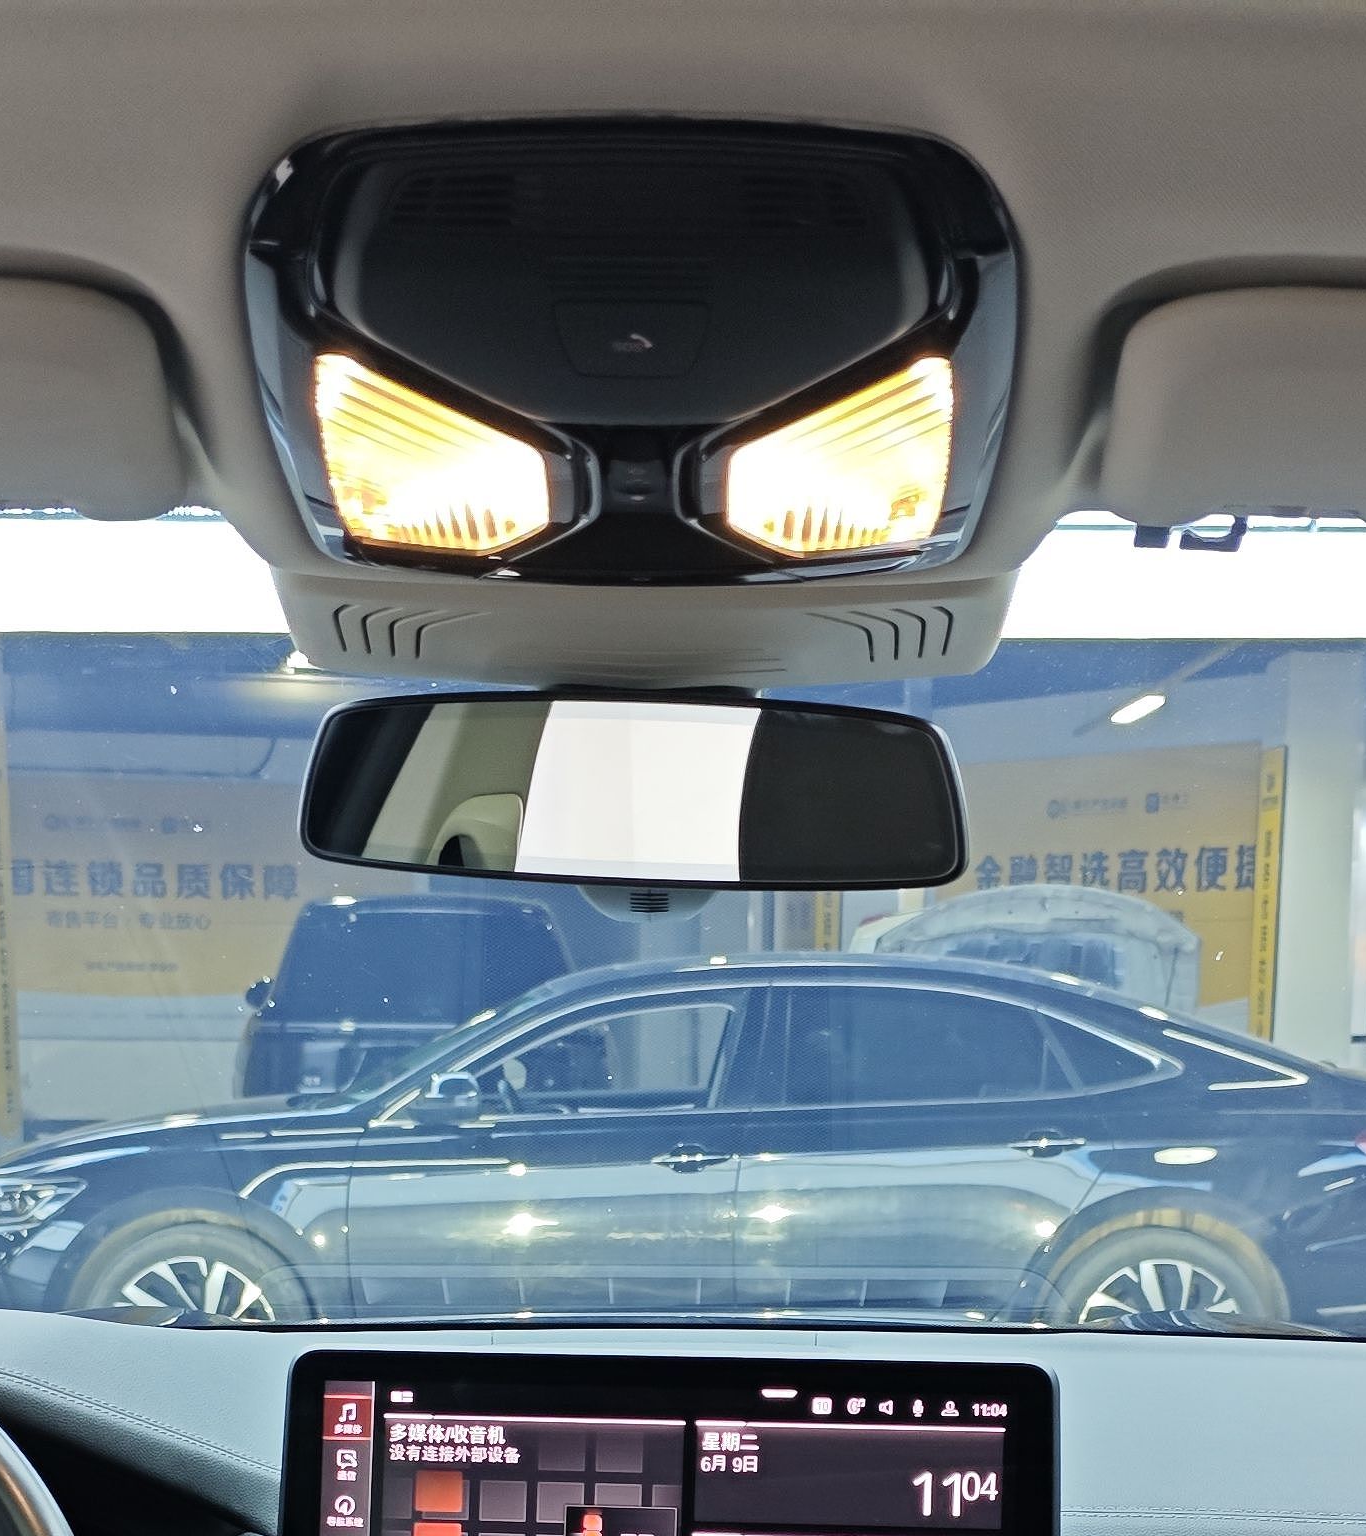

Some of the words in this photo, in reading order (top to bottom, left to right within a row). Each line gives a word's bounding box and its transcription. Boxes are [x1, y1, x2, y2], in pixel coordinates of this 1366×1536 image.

[971, 1403, 1008, 1417] 11:04
[389, 1424, 506, 1444] 多媒体/收音机
[702, 1432, 760, 1452] 星期二
[389, 1445, 521, 1464] 没有连接外部设备
